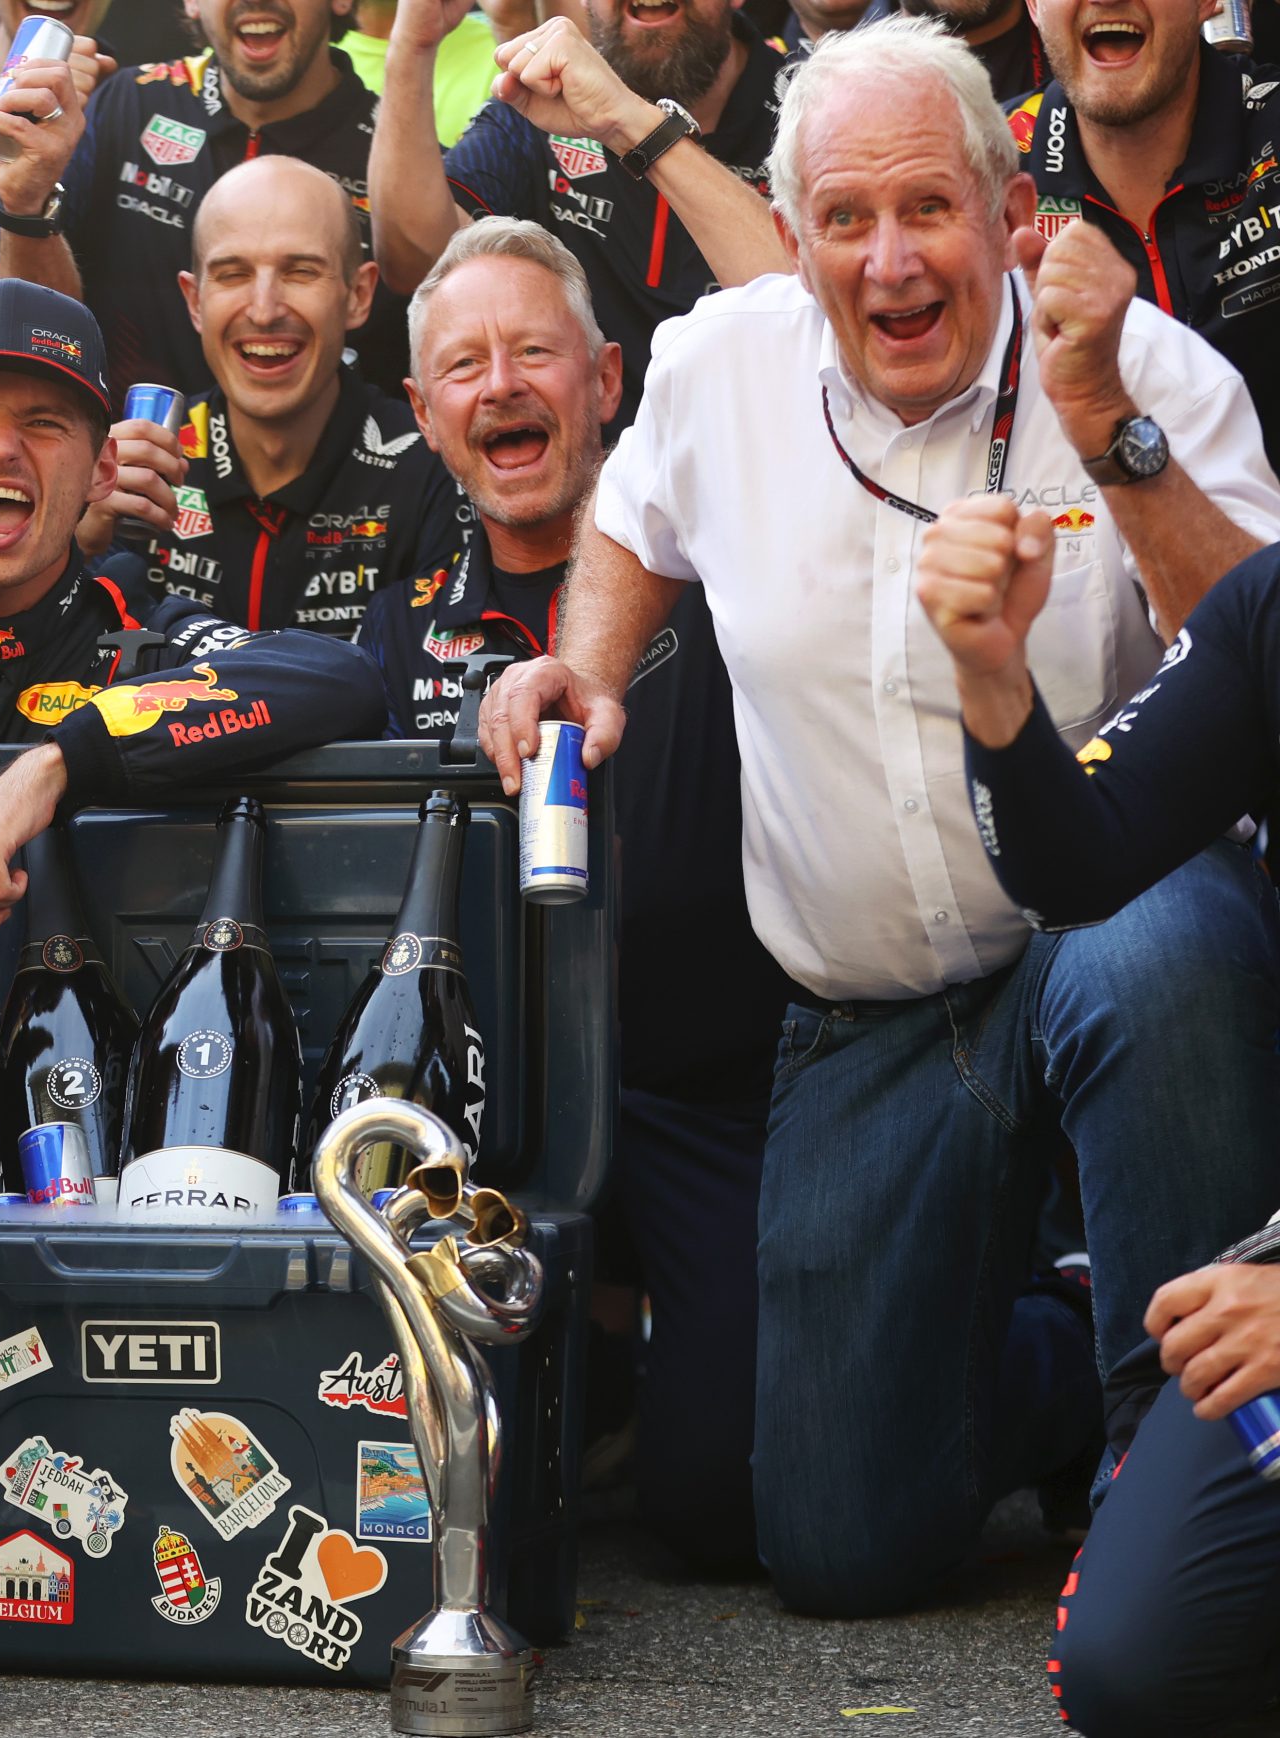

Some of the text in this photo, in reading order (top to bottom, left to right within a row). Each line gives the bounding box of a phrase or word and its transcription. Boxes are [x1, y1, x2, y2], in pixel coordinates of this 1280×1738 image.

[156, 121, 202, 145] TAG
[1045, 106, 1067, 172] zoom
[1204, 140, 1274, 197] ORALE
[1213, 246, 1280, 287] HOND
[31, 328, 82, 348] ORACLE
[31, 336, 61, 348] Red Bull
[31, 346, 82, 365] RACING
[210, 413, 233, 479] zoom
[172, 487, 208, 510] TA
[305, 564, 379, 597] BYBIT
[296, 605, 367, 623] HOND
[2, 641, 26, 661] Bull
[638, 639, 671, 667] HAN
[39, 693, 88, 713] RAUC
[168, 699, 271, 748] Red Bull
[416, 710, 460, 730] ORA
[570, 779, 589, 800] Re
[191, 1034, 222, 1044] 2023
[195, 1042, 211, 1066] 1
[58, 1062, 88, 1073] 2023
[62, 1070, 86, 1096] 2
[344, 1078, 370, 1088] 2023
[346, 1087, 361, 1107] 1
[26, 1176, 93, 1203] Red Bull
[0, 1344, 42, 1377] ITALY
[90, 1334, 207, 1372] YETI
[39, 1464, 85, 1495] JEDDAH
[217, 1473, 287, 1536] BARCELONA
[363, 1522, 427, 1538] MONACO
[270, 1509, 325, 1581] I
[159, 1583, 219, 1621] BUDAPEST
[255, 1570, 358, 1643] ZAND
